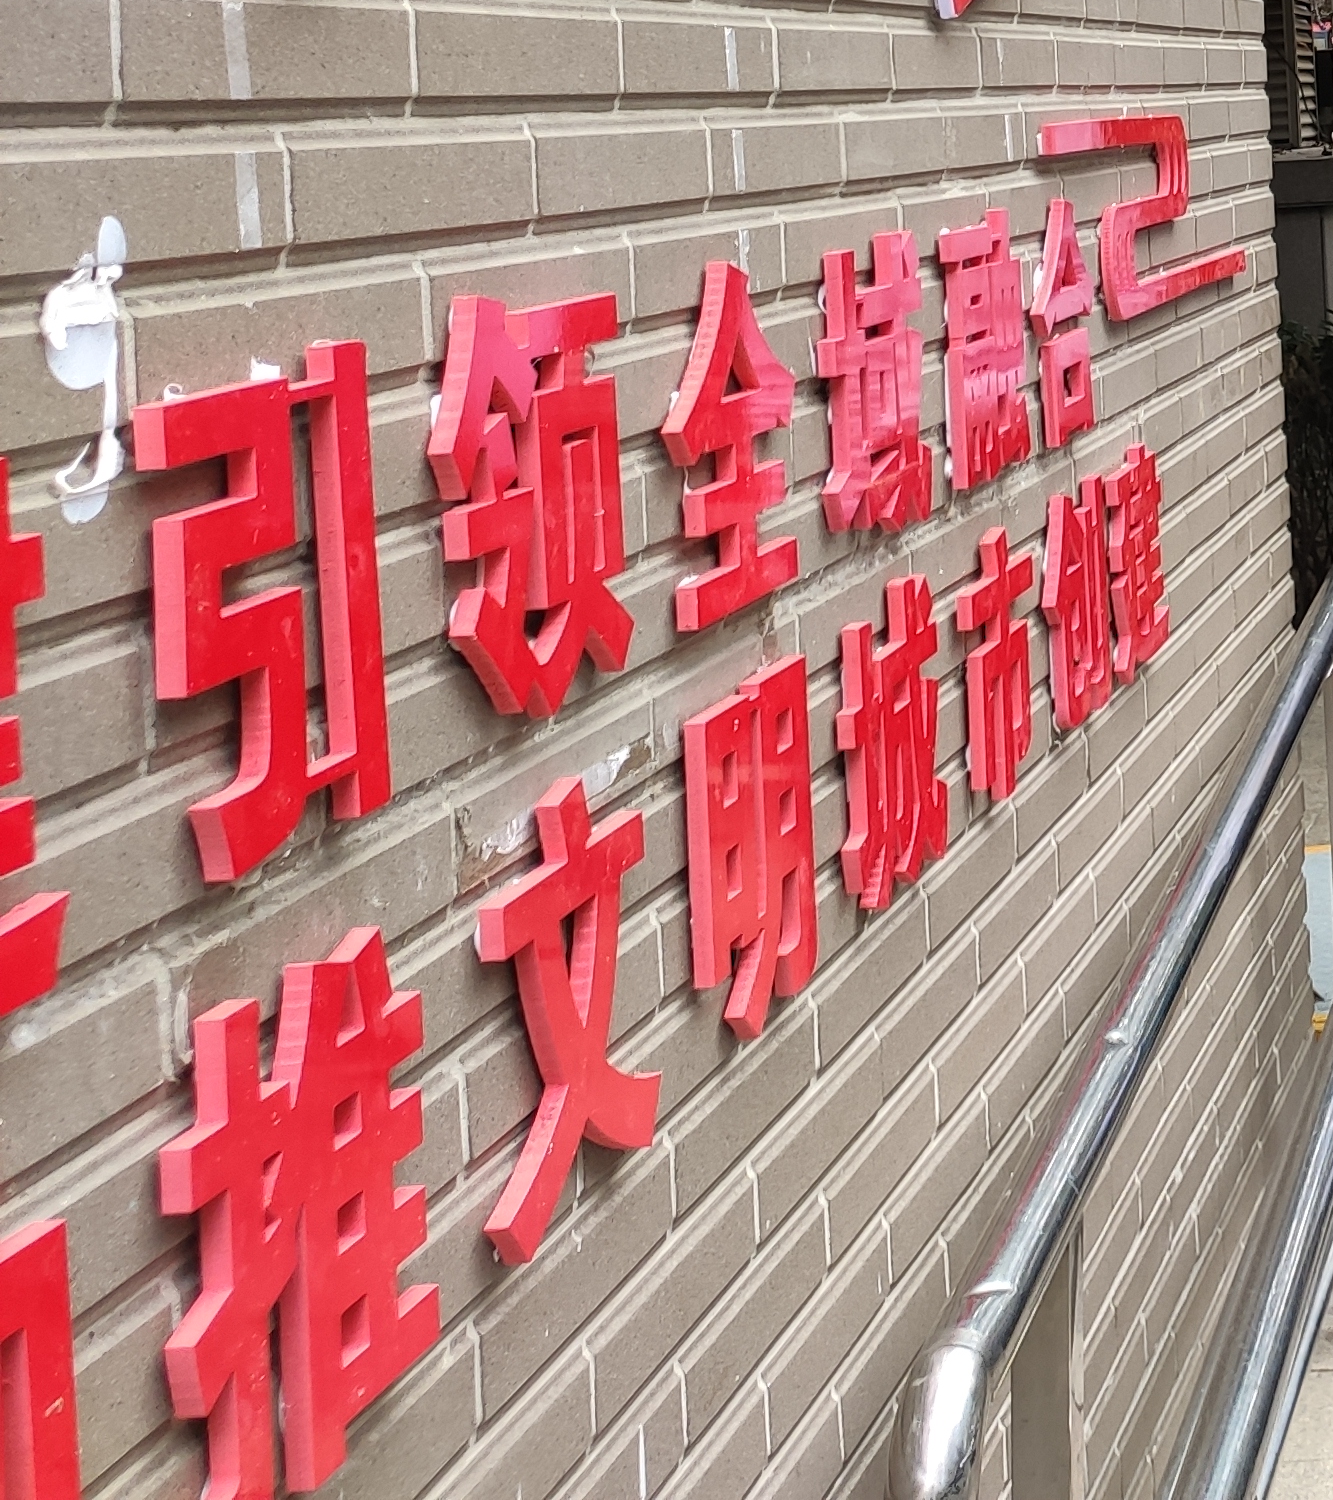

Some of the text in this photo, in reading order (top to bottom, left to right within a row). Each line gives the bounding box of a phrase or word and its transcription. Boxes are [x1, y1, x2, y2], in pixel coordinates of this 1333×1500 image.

[0, 197, 1097, 1016] 引领全域融合
[0, 442, 1171, 1500] 推文明城市创建
